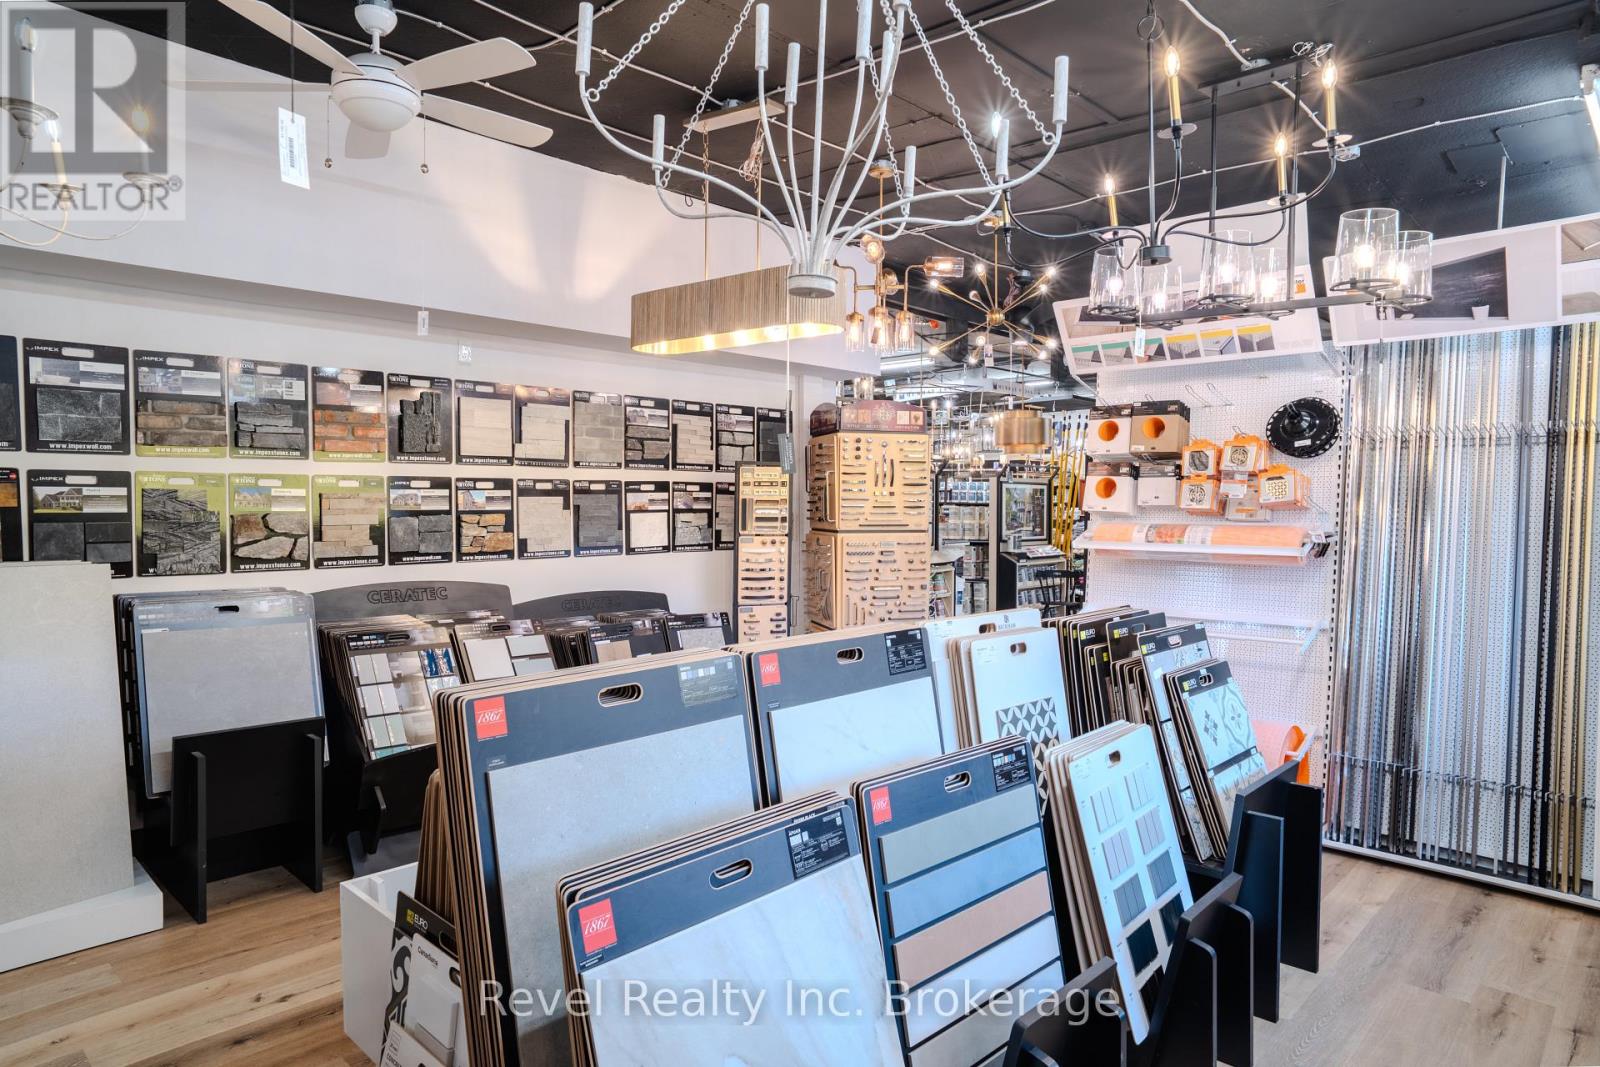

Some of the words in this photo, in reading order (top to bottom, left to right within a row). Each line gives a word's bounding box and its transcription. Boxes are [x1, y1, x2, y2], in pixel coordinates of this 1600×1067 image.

[239, 561, 301, 570] www.impexstones.com
[323, 558, 378, 566] www.impexstones.com
[367, 586, 448, 604] CERATEC
[414, 913, 428, 930] EURO
[585, 914, 610, 935] 1867
